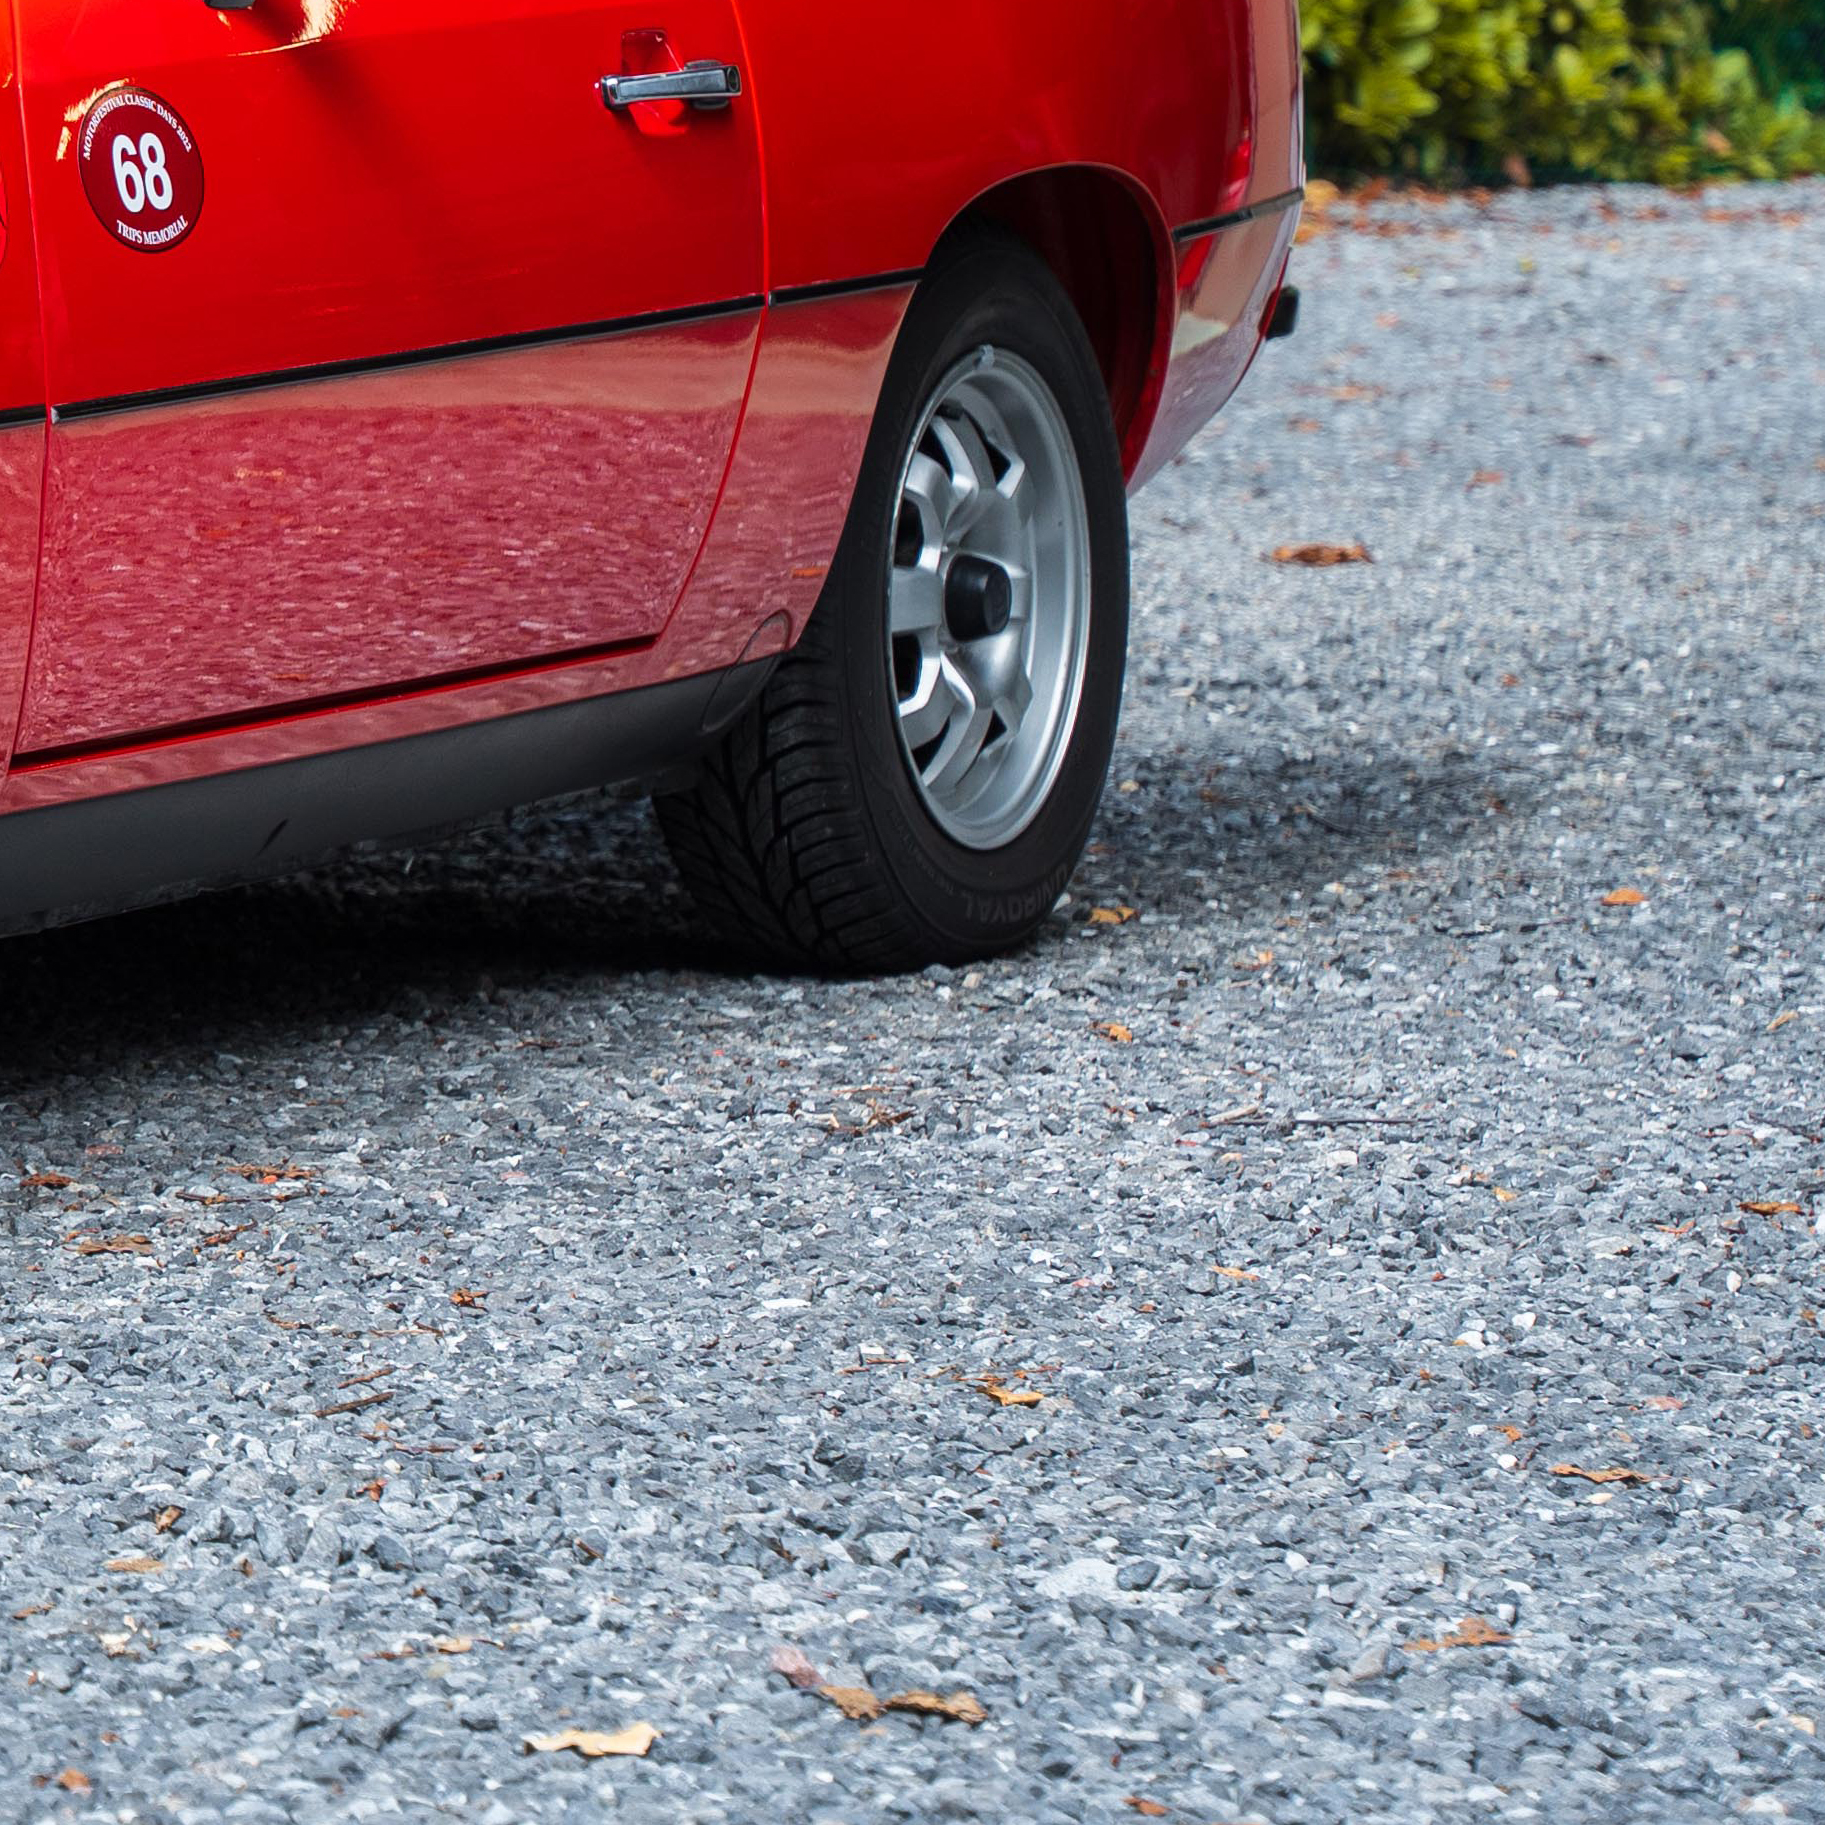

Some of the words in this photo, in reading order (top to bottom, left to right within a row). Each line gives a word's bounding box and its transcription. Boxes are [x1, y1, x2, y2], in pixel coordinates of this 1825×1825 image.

[83, 94, 126, 160] MOTORFESTIVAL
[125, 94, 157, 112] CLASSIC
[156, 102, 177, 128] DAYS
[112, 132, 173, 213] 68
[116, 219, 143, 244] TRIPS
[143, 215, 188, 245] MEMORIAL
